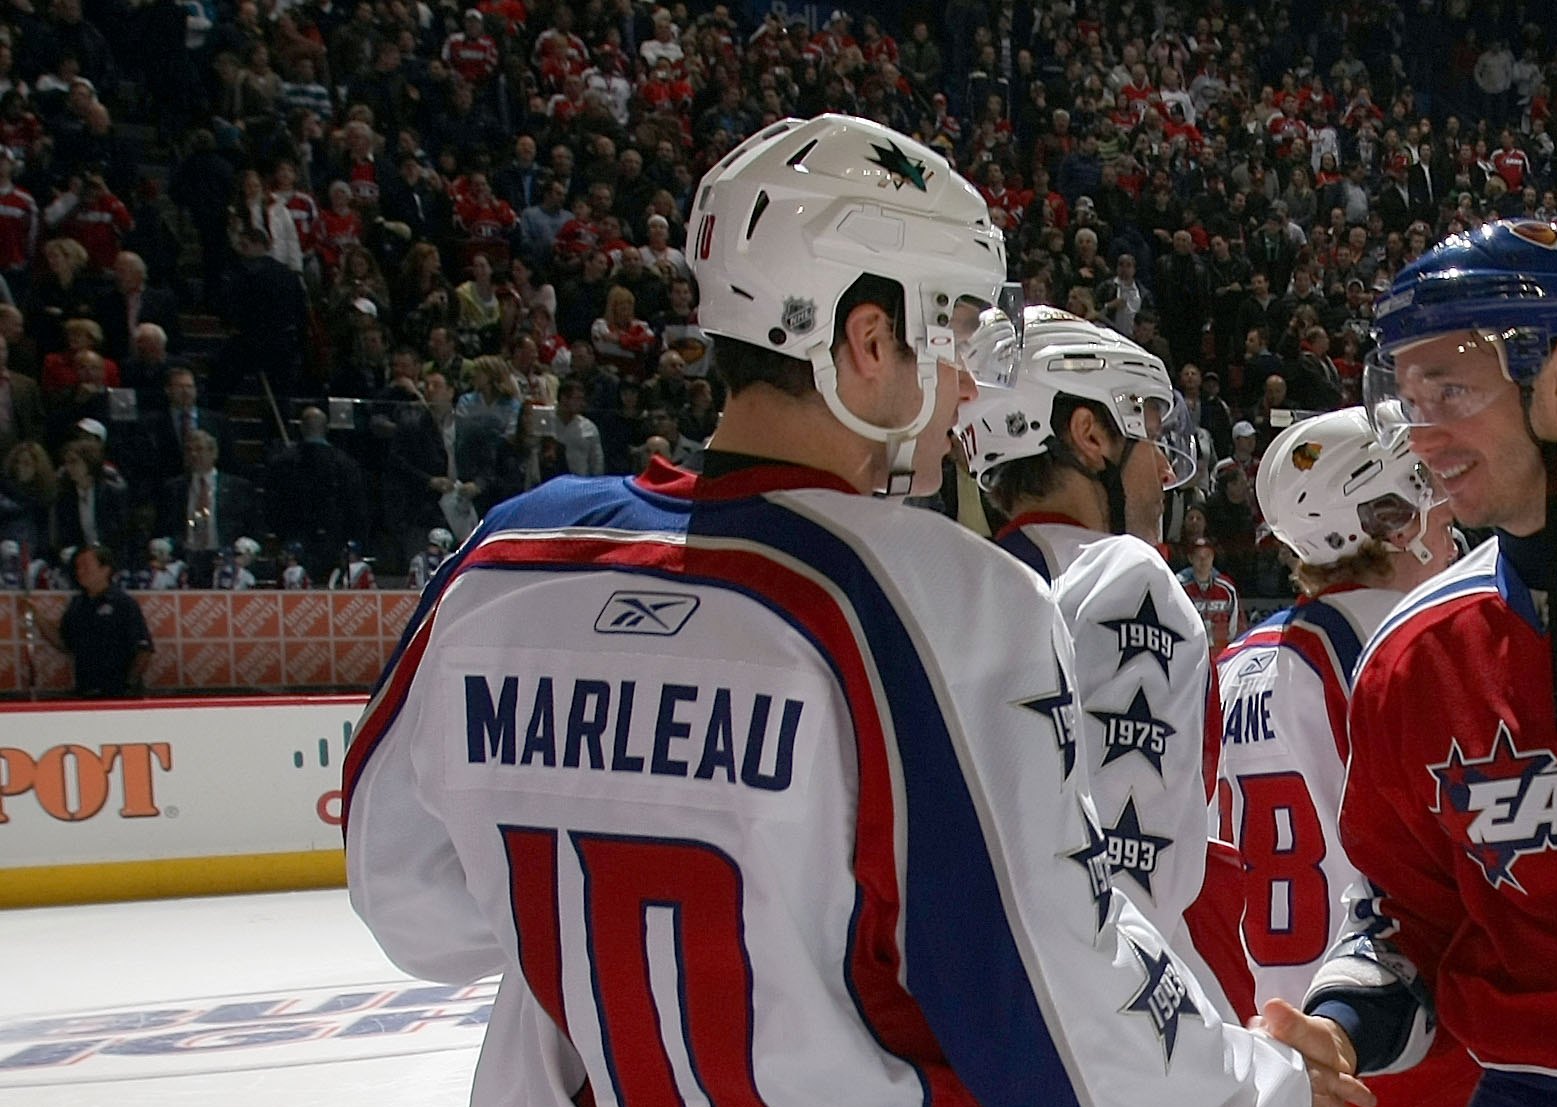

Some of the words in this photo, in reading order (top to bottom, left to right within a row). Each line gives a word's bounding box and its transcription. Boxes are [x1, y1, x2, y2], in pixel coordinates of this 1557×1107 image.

[1119, 623, 1175, 660] 1969
[465, 676, 804, 792] MARLEAU
[1052, 702, 1076, 746] 19
[1108, 717, 1167, 755] 1975
[1223, 690, 1275, 745] ANE
[1086, 853, 1112, 895] 19
[1107, 836, 1157, 872] 993
[1217, 771, 1330, 967] 8
